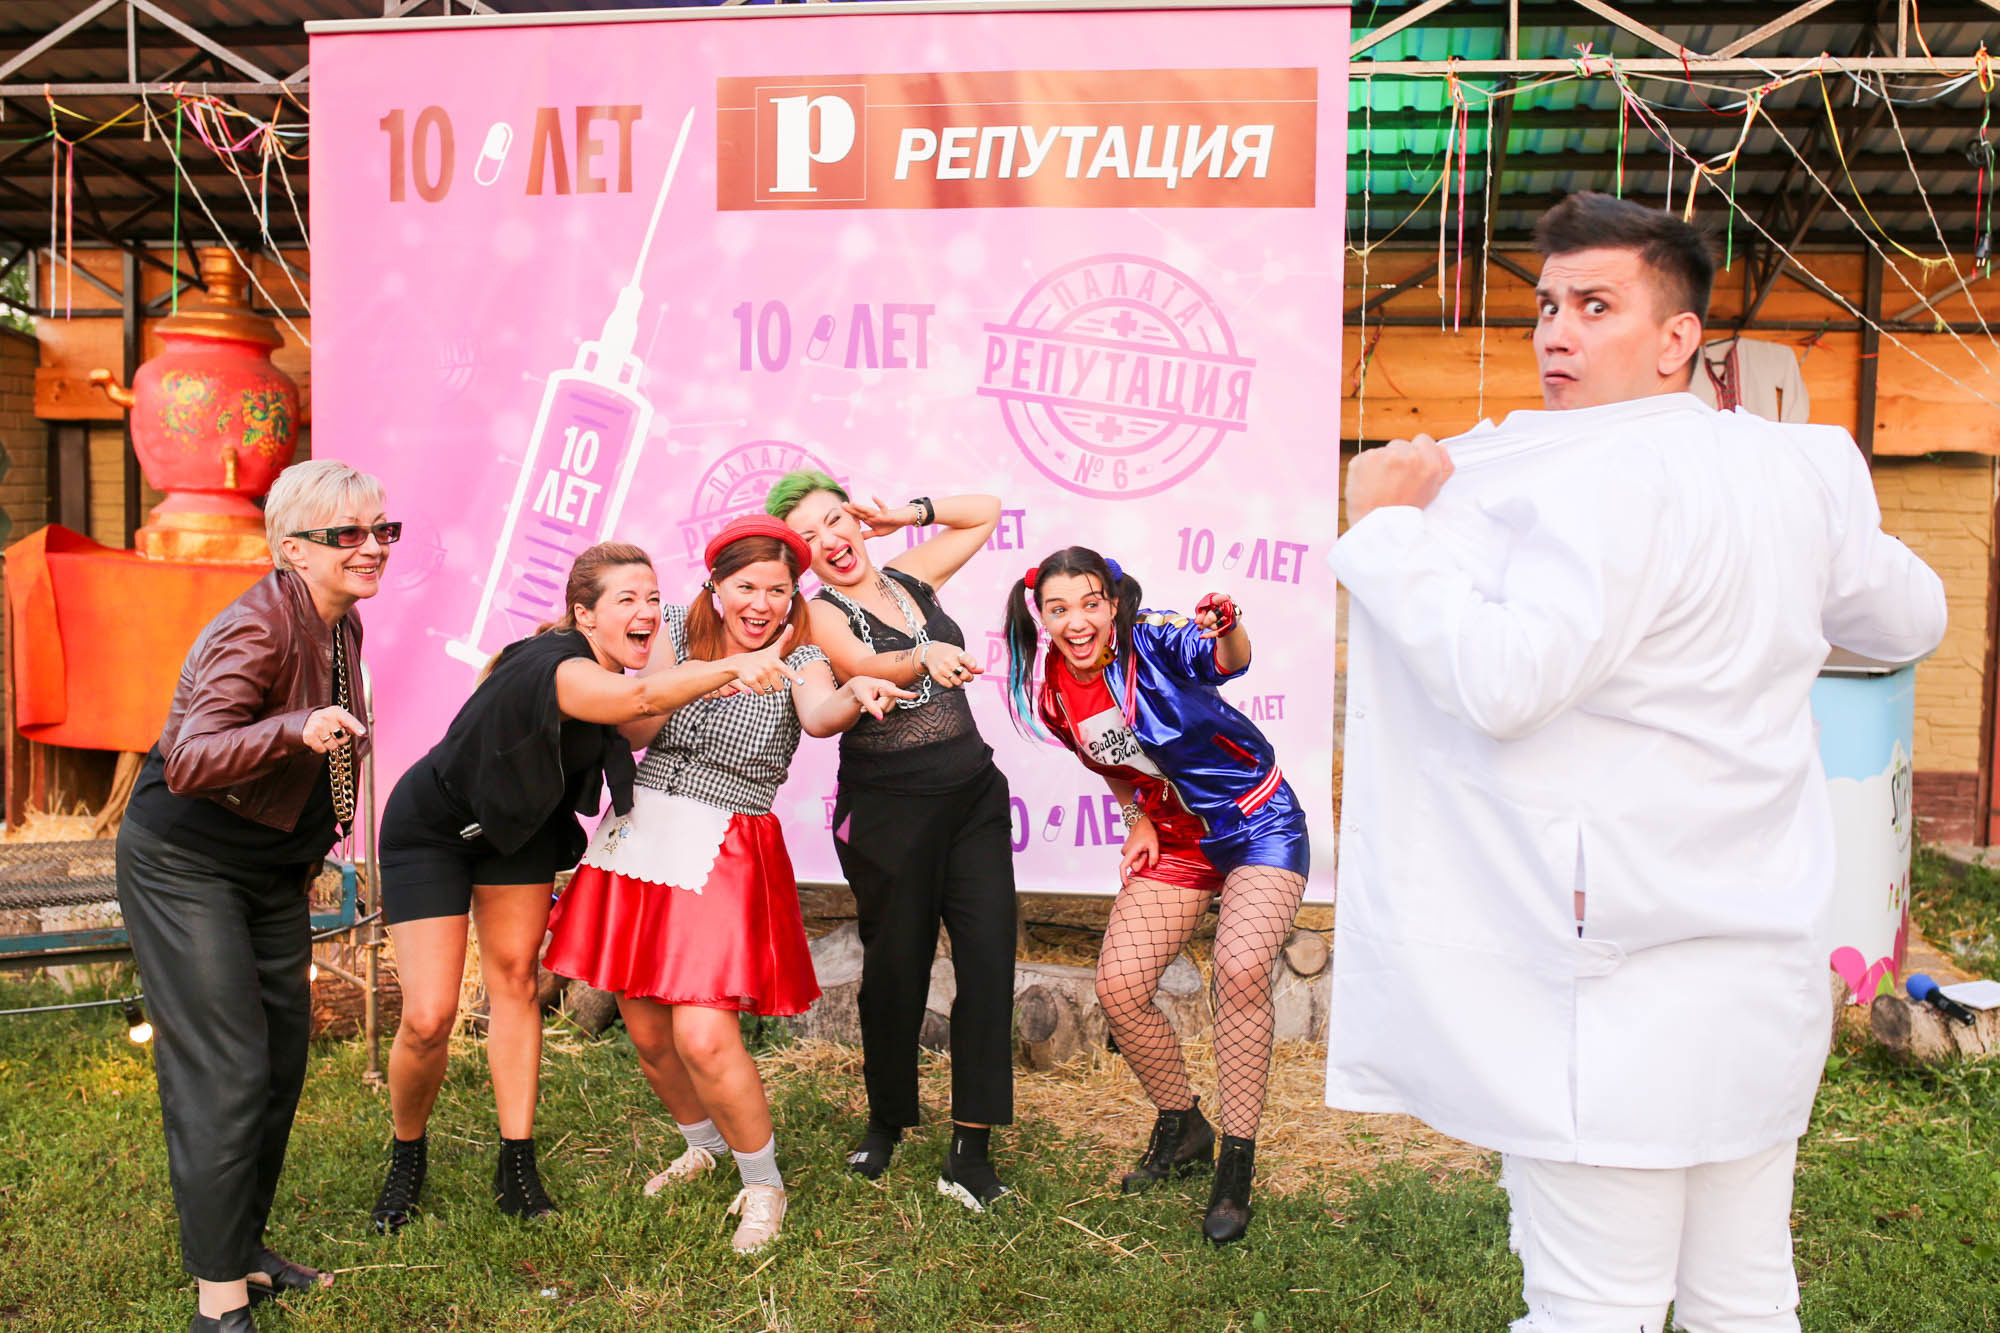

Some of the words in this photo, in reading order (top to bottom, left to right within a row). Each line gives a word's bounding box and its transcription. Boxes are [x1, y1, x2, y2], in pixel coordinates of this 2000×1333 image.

[379, 105, 455, 203] 10
[525, 104, 643, 195] ЛЕТ
[893, 125, 1275, 189] РЕПУТАЦИЯ
[1050, 264, 1204, 328] ПАЛАТА
[732, 300, 791, 373] 10
[844, 303, 936, 369] ЛЕТ
[984, 335, 1252, 420] РЕПУТАЦИЯ
[560, 425, 600, 476] 10
[532, 469, 602, 527] ЛЕТ
[1178, 527, 1215, 574] 10
[1246, 538, 1309, 584] ЛЕТ
[1251, 695, 1285, 721] ЛЕТ
